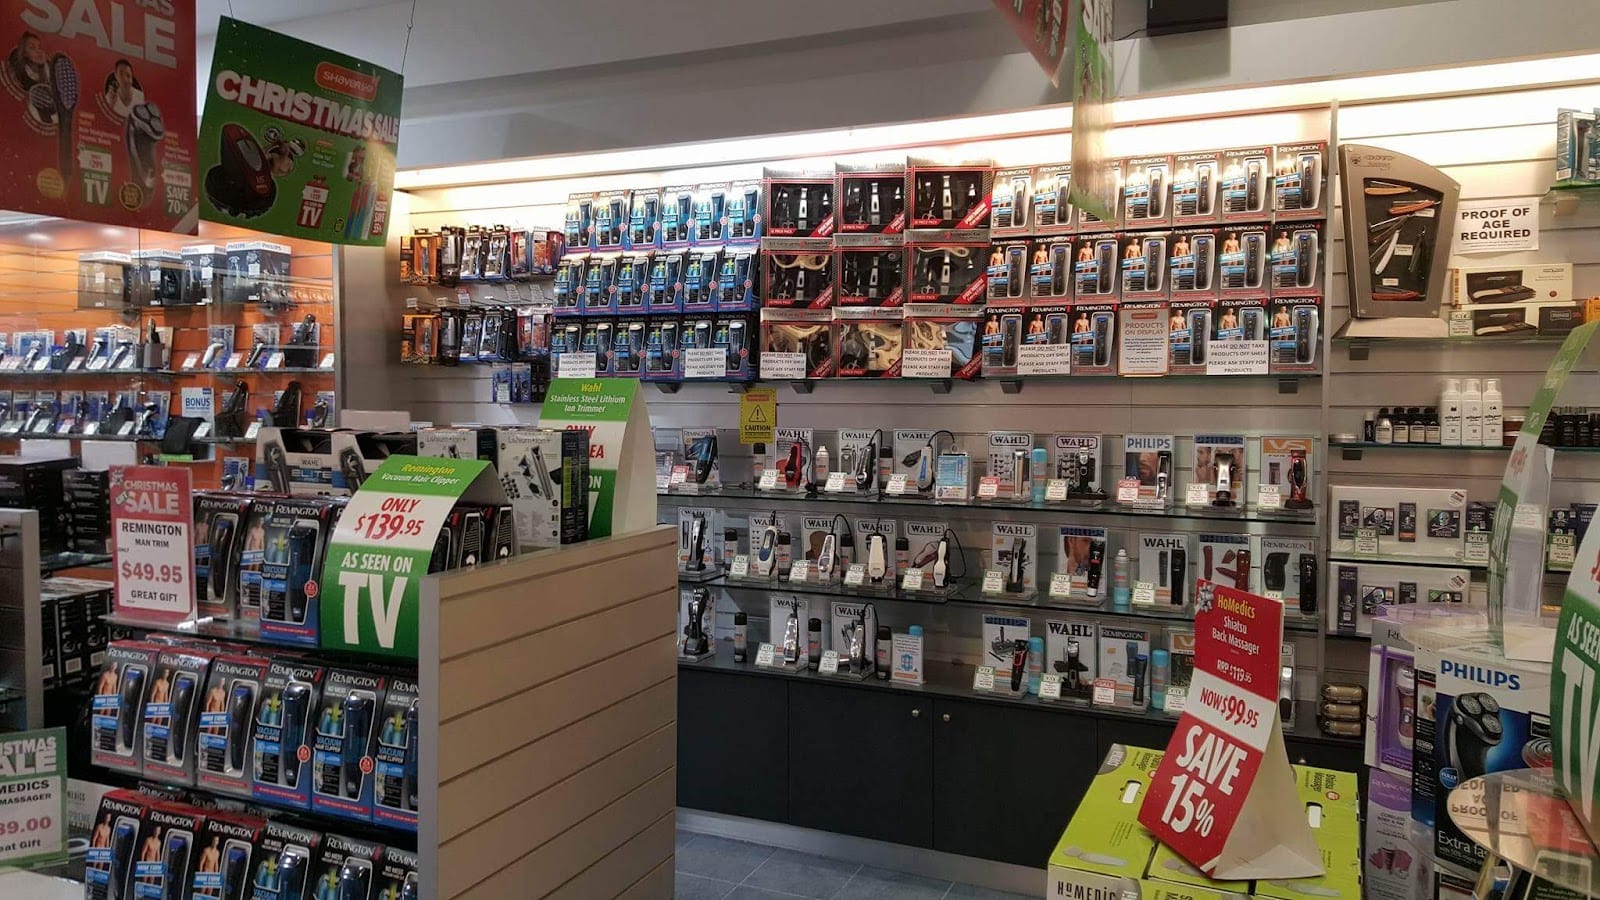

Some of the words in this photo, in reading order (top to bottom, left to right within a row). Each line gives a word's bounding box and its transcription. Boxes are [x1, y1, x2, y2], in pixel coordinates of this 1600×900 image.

[215, 70, 374, 140] CHRISTMAS
[374, 112, 399, 143] SALE
[84, 179, 109, 205] TV
[302, 205, 322, 226] TV
[1461, 209, 1508, 220] PROOF
[1512, 207, 1531, 217] OF
[1482, 219, 1511, 229] AGE
[1460, 229, 1531, 241] REQUIRED
[1076, 304, 1113, 312] REMINGTON
[1222, 299, 1261, 307] REMINGTON
[1274, 297, 1316, 306] REMINGTON
[581, 382, 602, 393] Wahl
[185, 397, 210, 408] BONUS
[550, 395, 580, 403] Stainless
[581, 395, 598, 403] Steel
[600, 395, 626, 404] Lithium
[564, 404, 576, 412] Ion
[577, 404, 606, 413] Trimmer
[744, 424, 771, 432] CAUTION
[777, 430, 806, 438] WAHL
[845, 431, 870, 439] WAHL
[902, 431, 928, 439] WAHL
[995, 436, 1025, 444] WAHL
[1060, 438, 1093, 447] WAHL
[1127, 438, 1171, 449] PHILIPS
[1268, 439, 1306, 450] VS
[402, 463, 456, 476] Remington
[382, 472, 411, 482] Vacuum
[412, 474, 430, 483] Hair
[431, 475, 460, 485] Clipper
[124, 480, 178, 492] CHRISTMAS
[124, 490, 180, 516] SALE
[200, 500, 240, 510] REMINGTON
[381, 497, 421, 514] ONLY
[275, 504, 321, 516] REMINGTON
[121, 522, 183, 536] REMINGTON
[354, 511, 425, 541] $139.95
[912, 526, 941, 534] WAHL
[997, 524, 1032, 536] WAHL
[135, 538, 151, 547] MAN
[152, 539, 170, 548] TRIM
[1144, 537, 1184, 549] WAHL
[1263, 540, 1307, 549] REMINGTON
[341, 551, 358, 568] AS
[360, 553, 391, 572] SEEN
[393, 556, 414, 574] ON
[121, 560, 183, 584] $49.95
[131, 589, 157, 601] GREAT
[160, 592, 178, 603] GIFT
[338, 571, 409, 649] TV
[1217, 594, 1256, 619] HoMedics
[1048, 622, 1092, 637] WAHL
[1223, 615, 1248, 635] Shiatsu
[1566, 612, 1581, 645] AS
[1101, 629, 1143, 639] REMINGTON
[1212, 627, 1227, 644] Back
[1228, 634, 1260, 656] Massager
[107, 649, 149, 662] REMINGTON
[160, 655, 200, 669] REMINGTON
[215, 663, 260, 678] REMINGTON
[270, 663, 315, 679] REMINGTON
[1216, 659, 1230, 674] RRP
[330, 671, 379, 688] REMINGTON
[1440, 659, 1521, 690] PHILIPS
[1200, 687, 1222, 711] NOW
[1220, 695, 1260, 729] $99.95
[256, 726, 280, 737] VACUUM
[1561, 646, 1600, 823] TV
[316, 736, 342, 747] VACUUM
[379, 747, 404, 758] VACUUM
[1176, 724, 1248, 796] SAVE
[102, 798, 141, 816] REMINGTON
[1161, 773, 1215, 838] 15%
[150, 810, 194, 828] REMINGTON
[208, 820, 253, 838] REMINGTON
[267, 826, 313, 844] REMINGTON
[20, 839, 41, 850] Gift
[327, 836, 375, 857] REMINGTON
[1438, 830, 1471, 852] Extra
